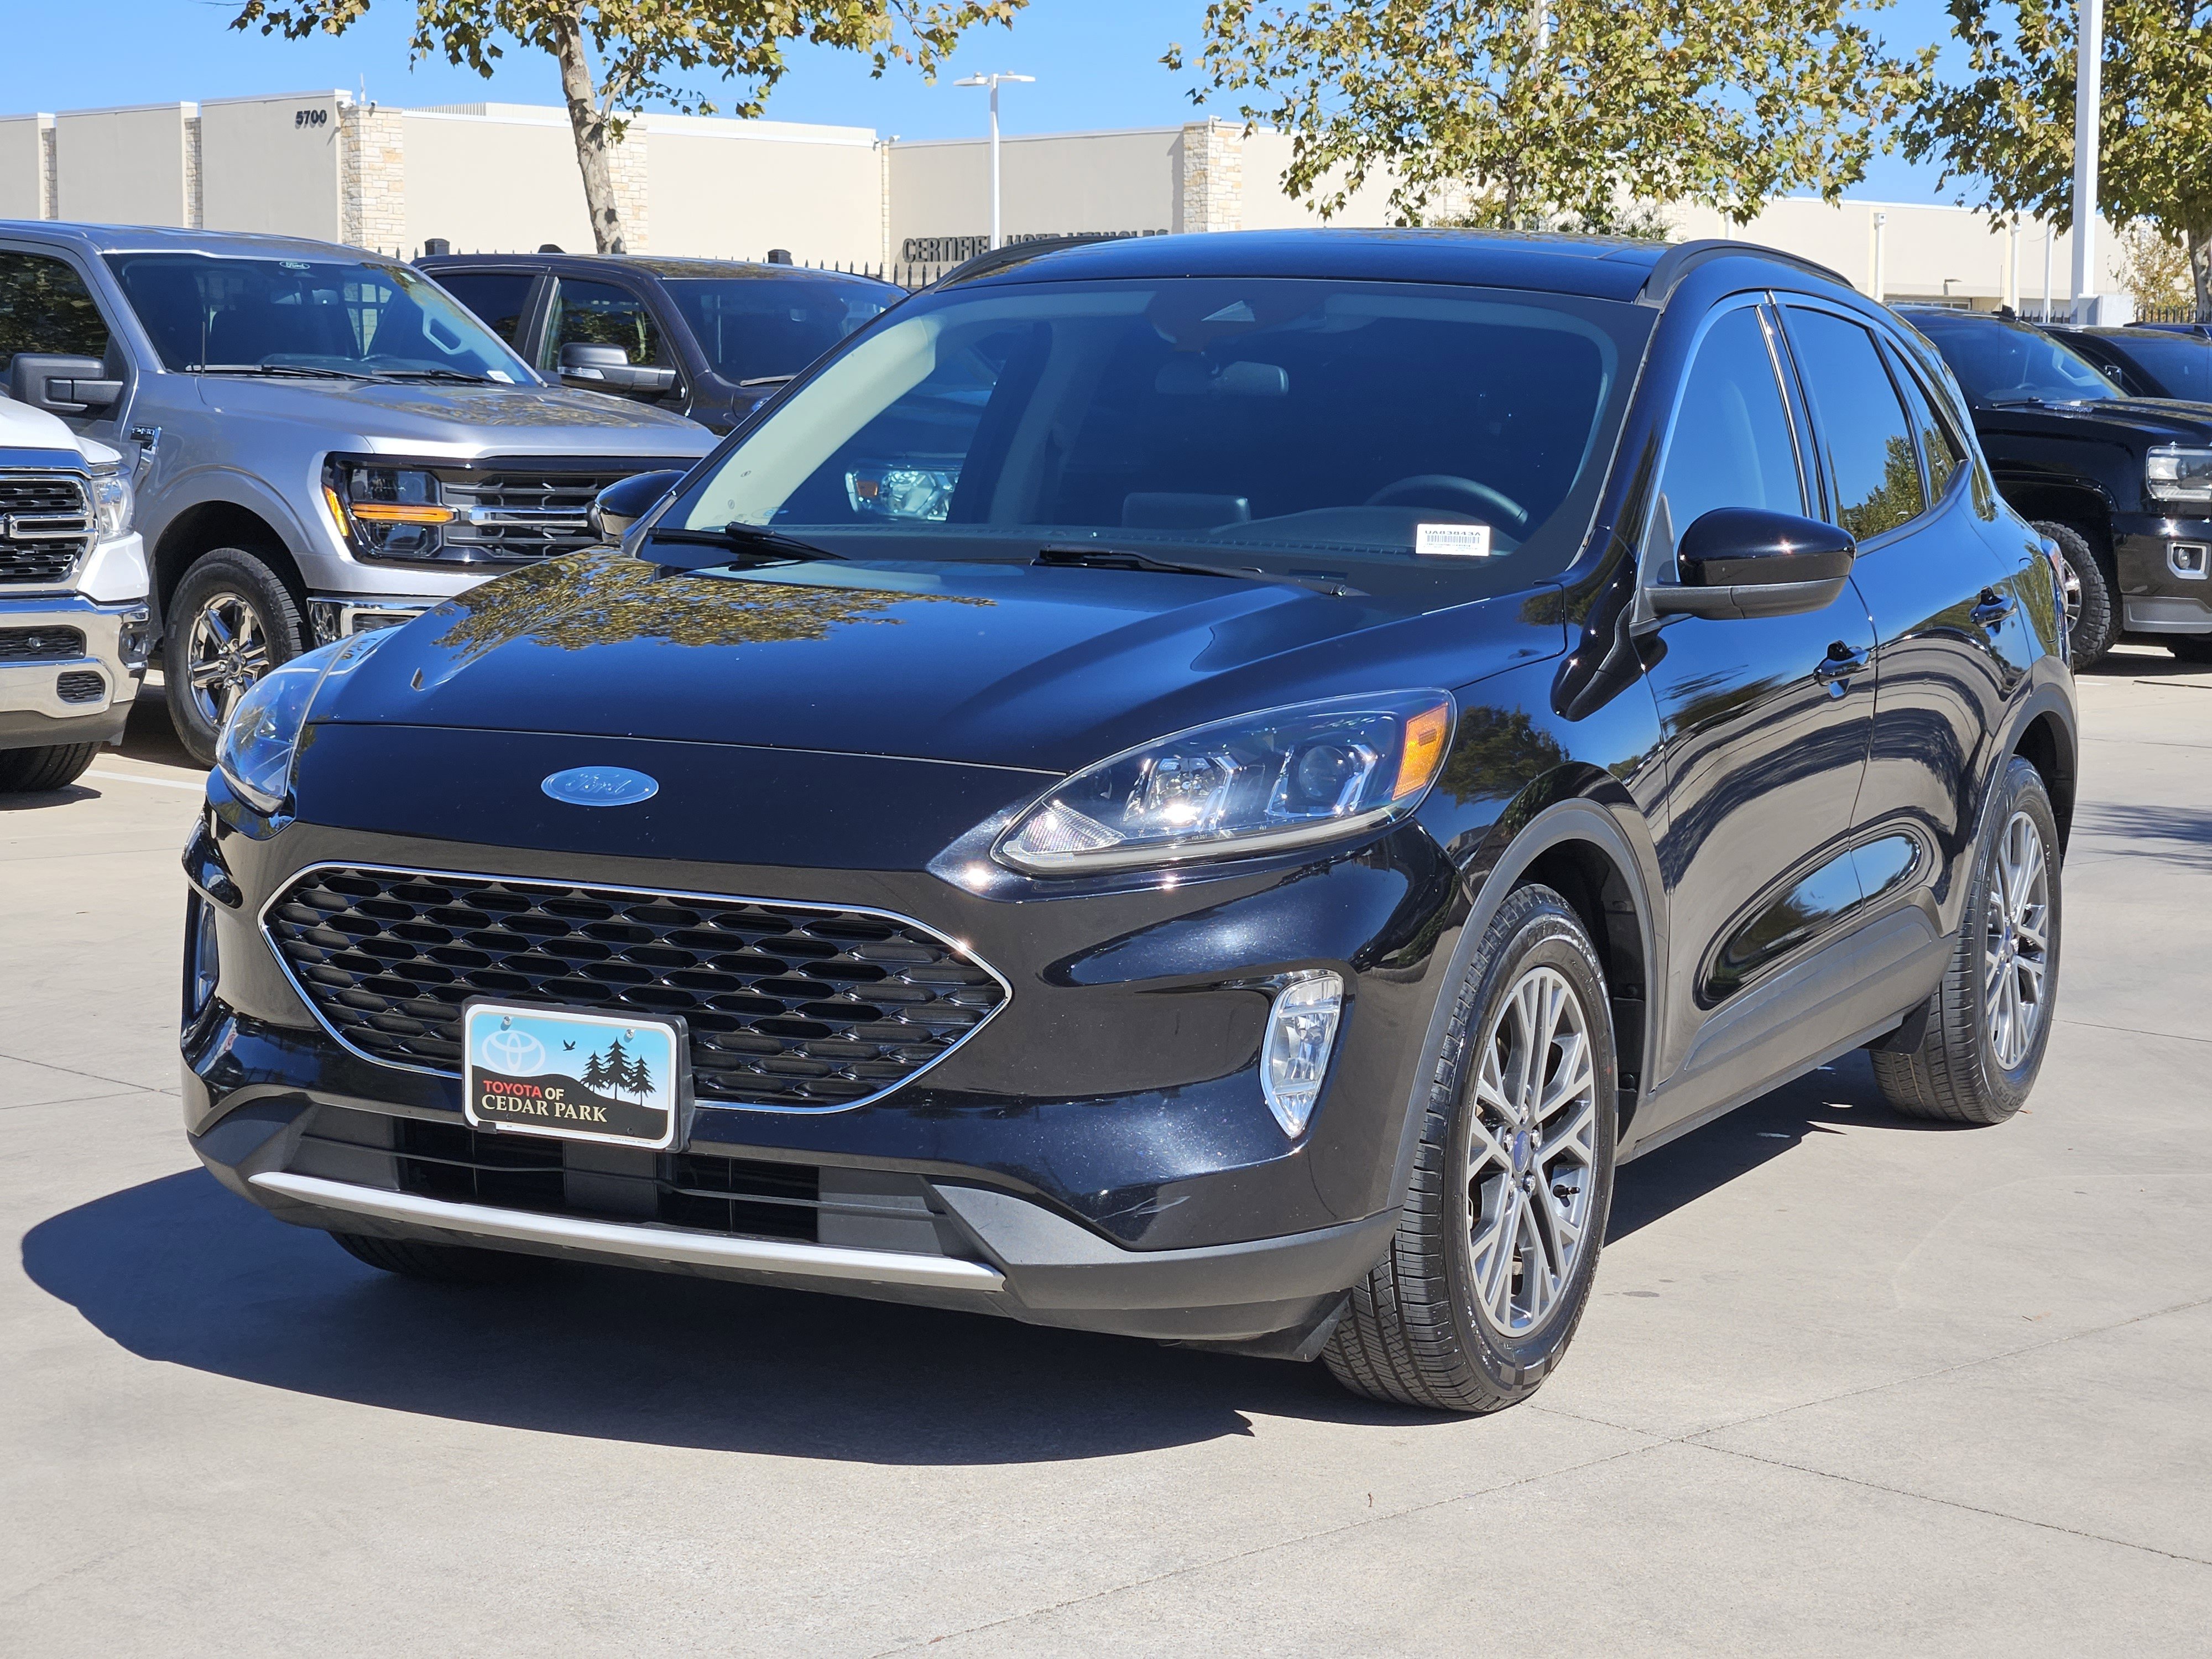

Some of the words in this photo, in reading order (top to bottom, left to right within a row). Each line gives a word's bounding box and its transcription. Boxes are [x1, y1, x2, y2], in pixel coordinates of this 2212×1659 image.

[295, 109, 327, 126] 5700
[902, 236, 1000, 263] CERTIFIE
[483, 1080, 542, 1098] TOYOTA
[545, 1087, 565, 1100] OF
[482, 1094, 549, 1117] CEDAR
[554, 1102, 608, 1123] PARK
